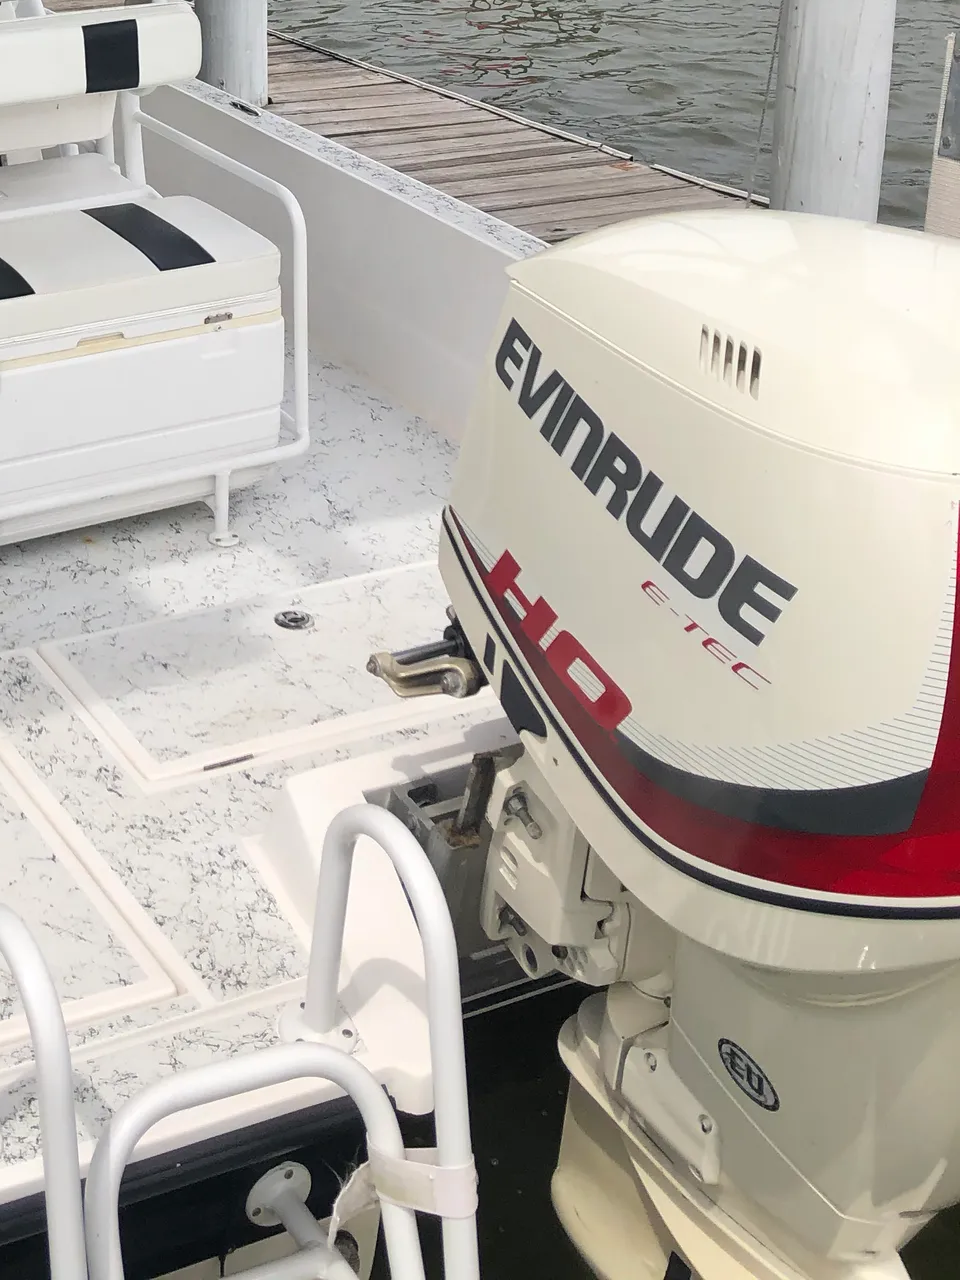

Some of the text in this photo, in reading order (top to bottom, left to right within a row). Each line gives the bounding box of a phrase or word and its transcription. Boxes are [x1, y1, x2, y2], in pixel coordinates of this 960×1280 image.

[495, 317, 799, 648] EVINRUDE
[486, 549, 633, 732] HO
[641, 580, 772, 690] E-TEC
